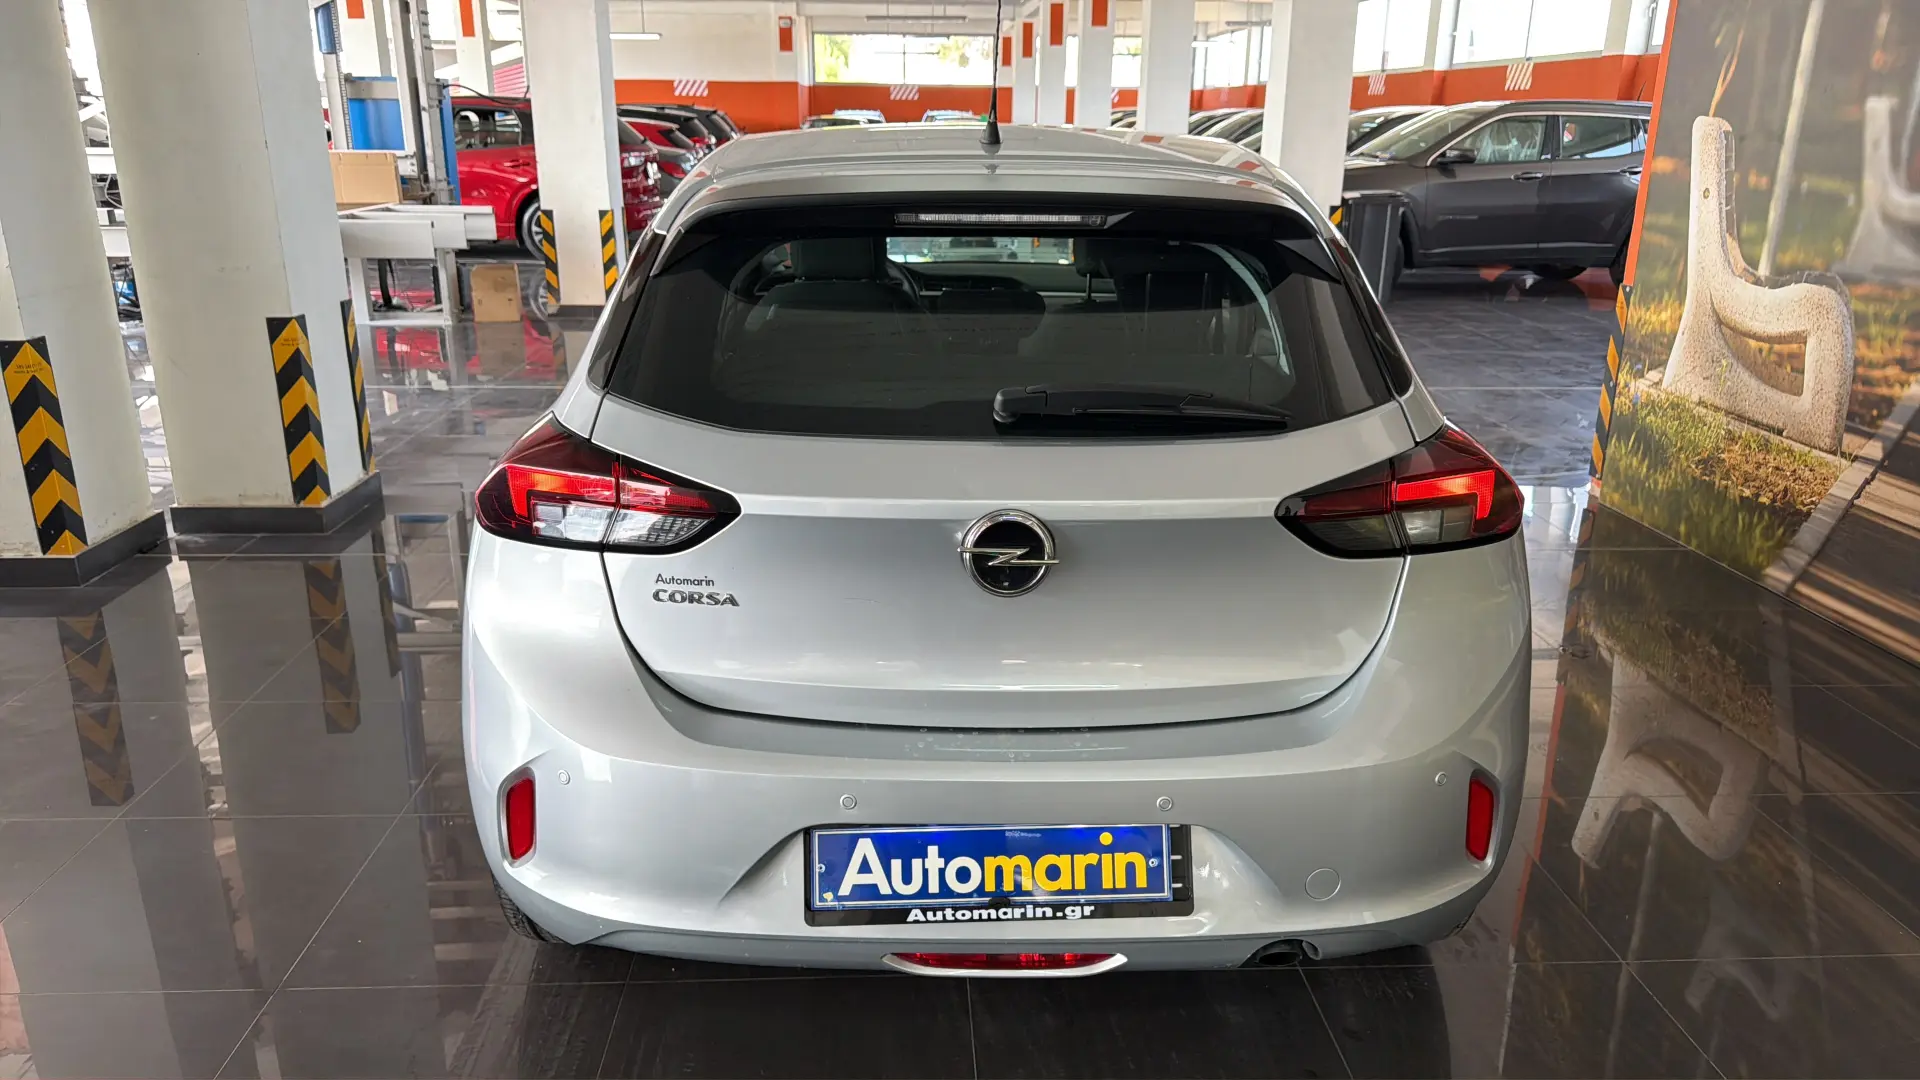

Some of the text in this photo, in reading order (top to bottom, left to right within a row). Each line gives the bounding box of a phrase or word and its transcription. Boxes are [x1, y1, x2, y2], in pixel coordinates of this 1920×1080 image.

[655, 573, 715, 587] Automarin
[652, 589, 740, 607] CORSA
[837, 832, 1147, 896] Automarin
[906, 904, 1096, 923] Automarin.gr
